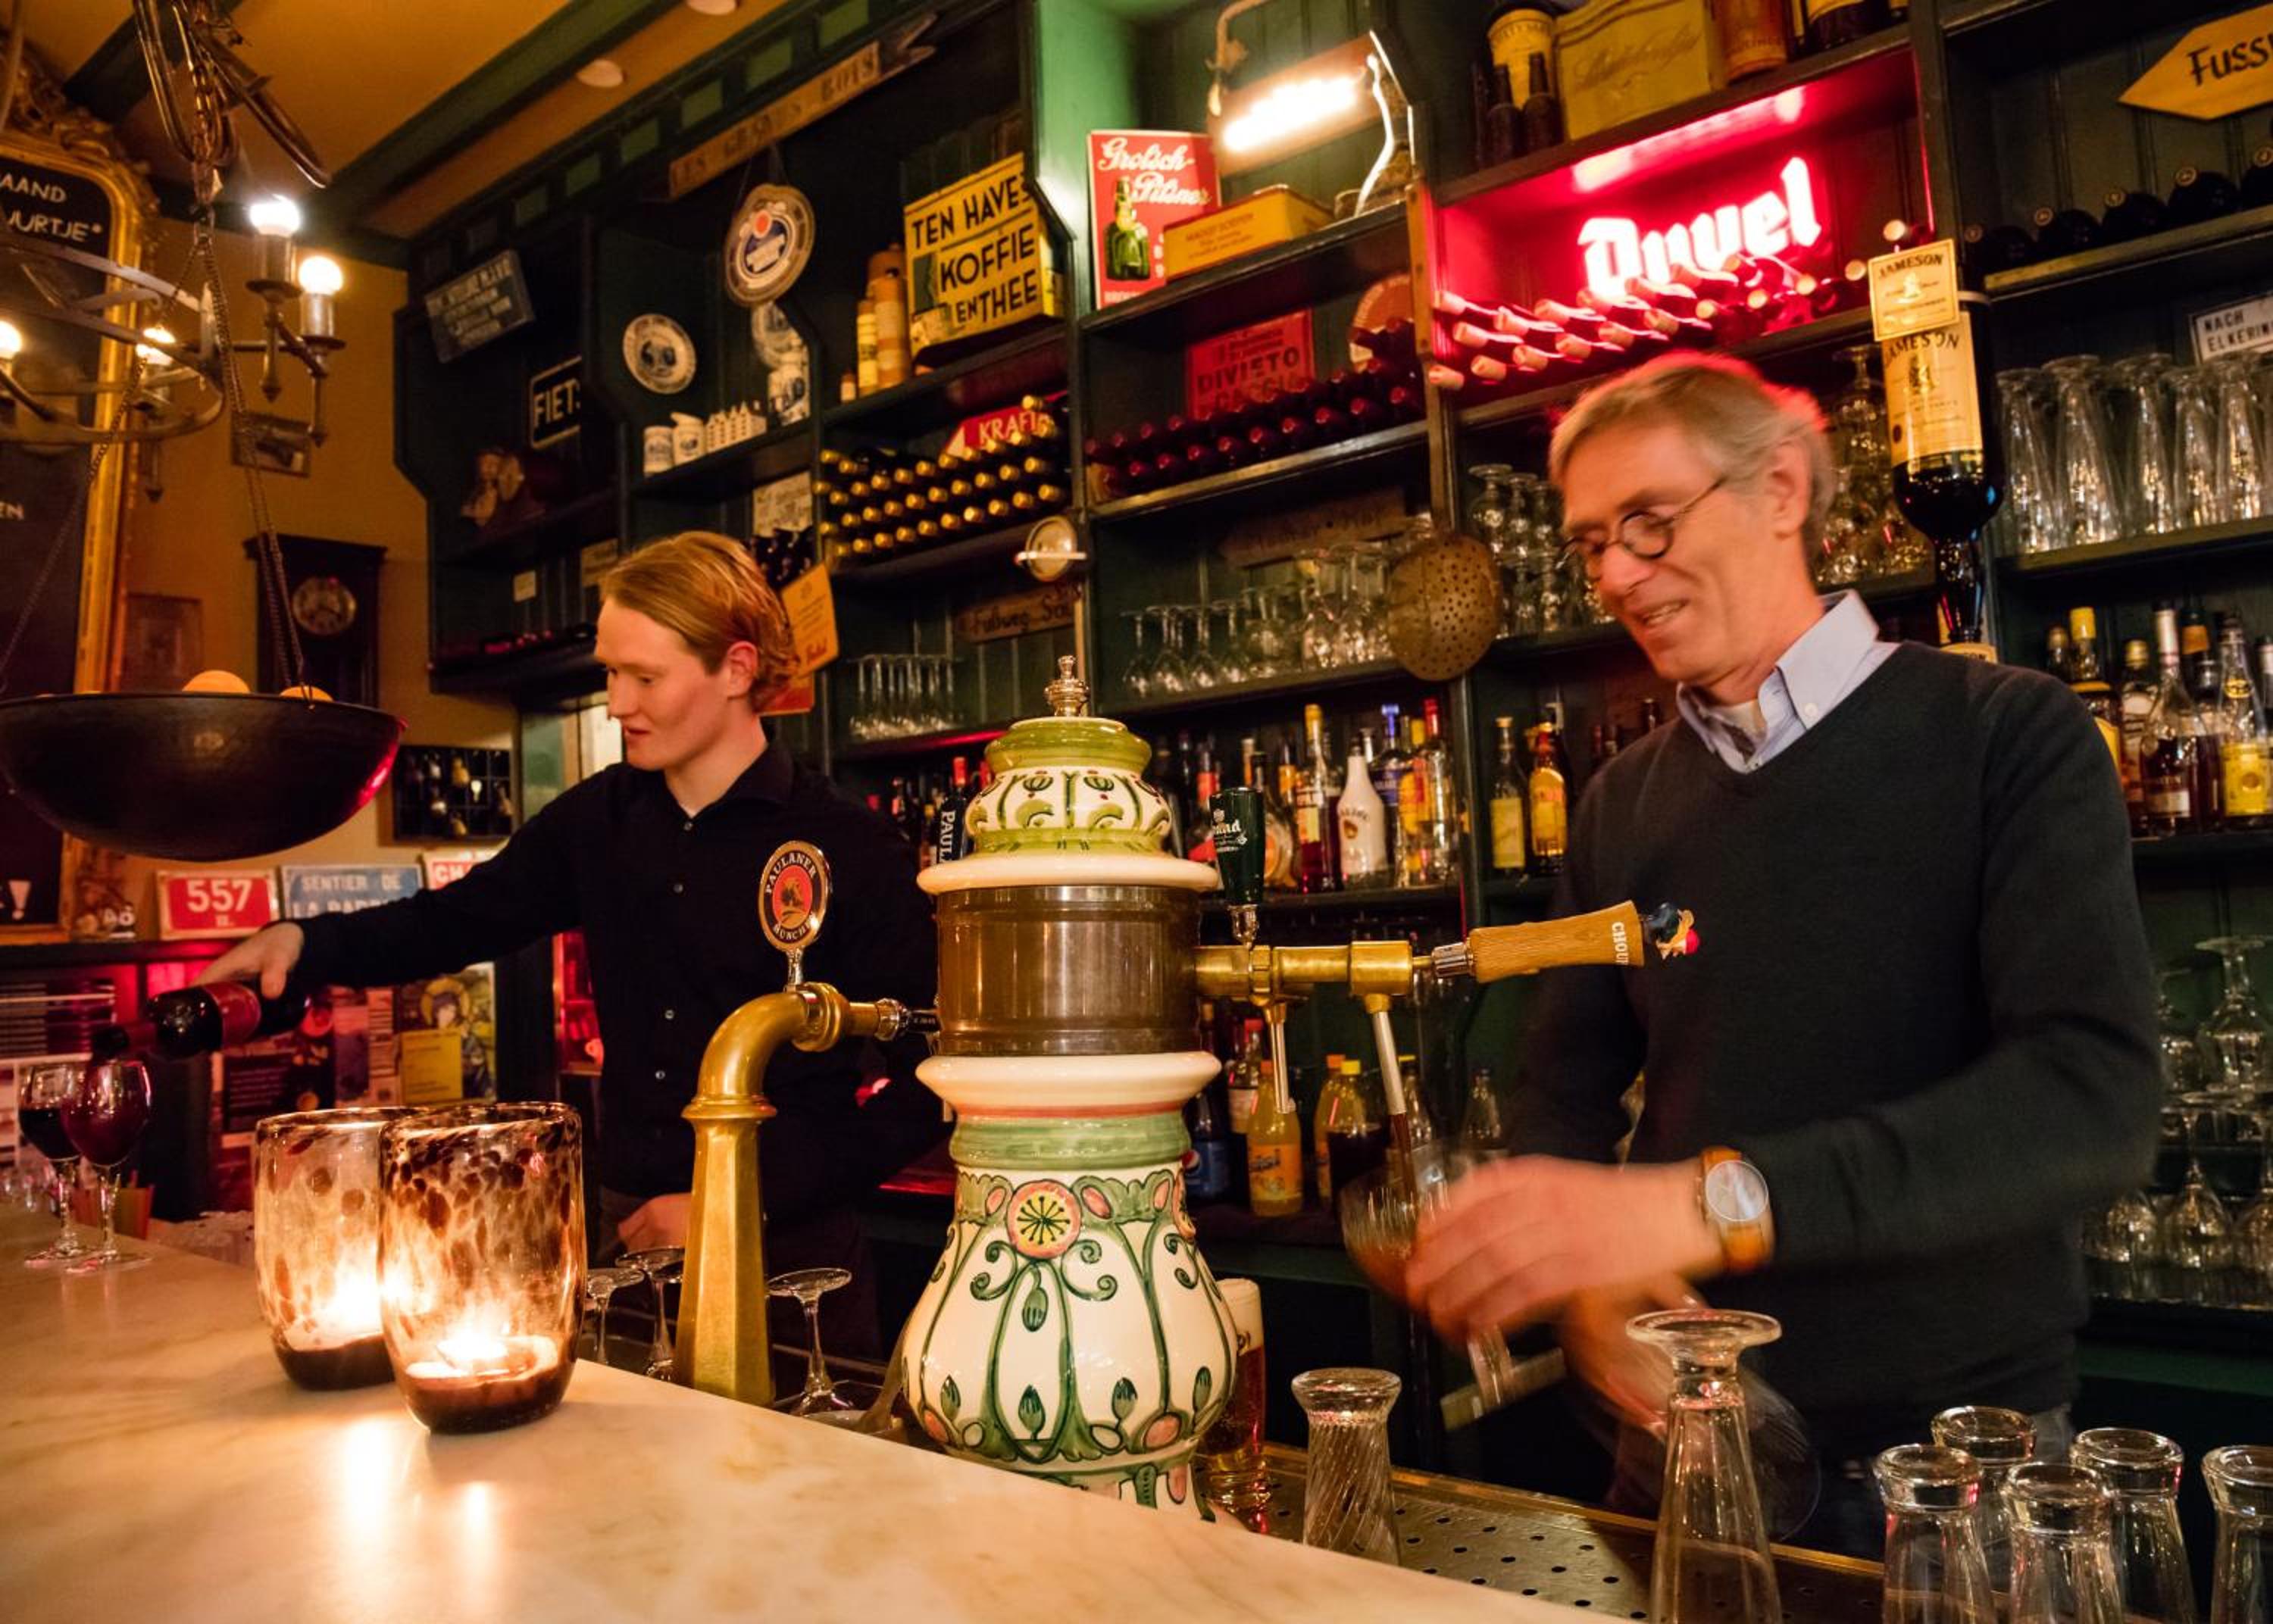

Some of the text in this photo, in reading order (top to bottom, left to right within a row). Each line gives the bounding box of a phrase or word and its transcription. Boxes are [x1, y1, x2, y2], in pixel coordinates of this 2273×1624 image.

[1098, 137, 1195, 171] Grolsch
[911, 205, 955, 249] TEN
[1577, 157, 1821, 301] Duvel
[940, 222, 1036, 293] KOFFIE
[1879, 254, 1944, 278] JAMESON
[956, 268, 1037, 323] EN THEE
[1197, 346, 1299, 394] DIVIETO
[940, 810, 956, 862] PAUL
[301, 873, 402, 891] SENTIER DE
[434, 863, 464, 883] CH
[765, 851, 817, 894] PAULANER
[186, 879, 252, 913] 557
